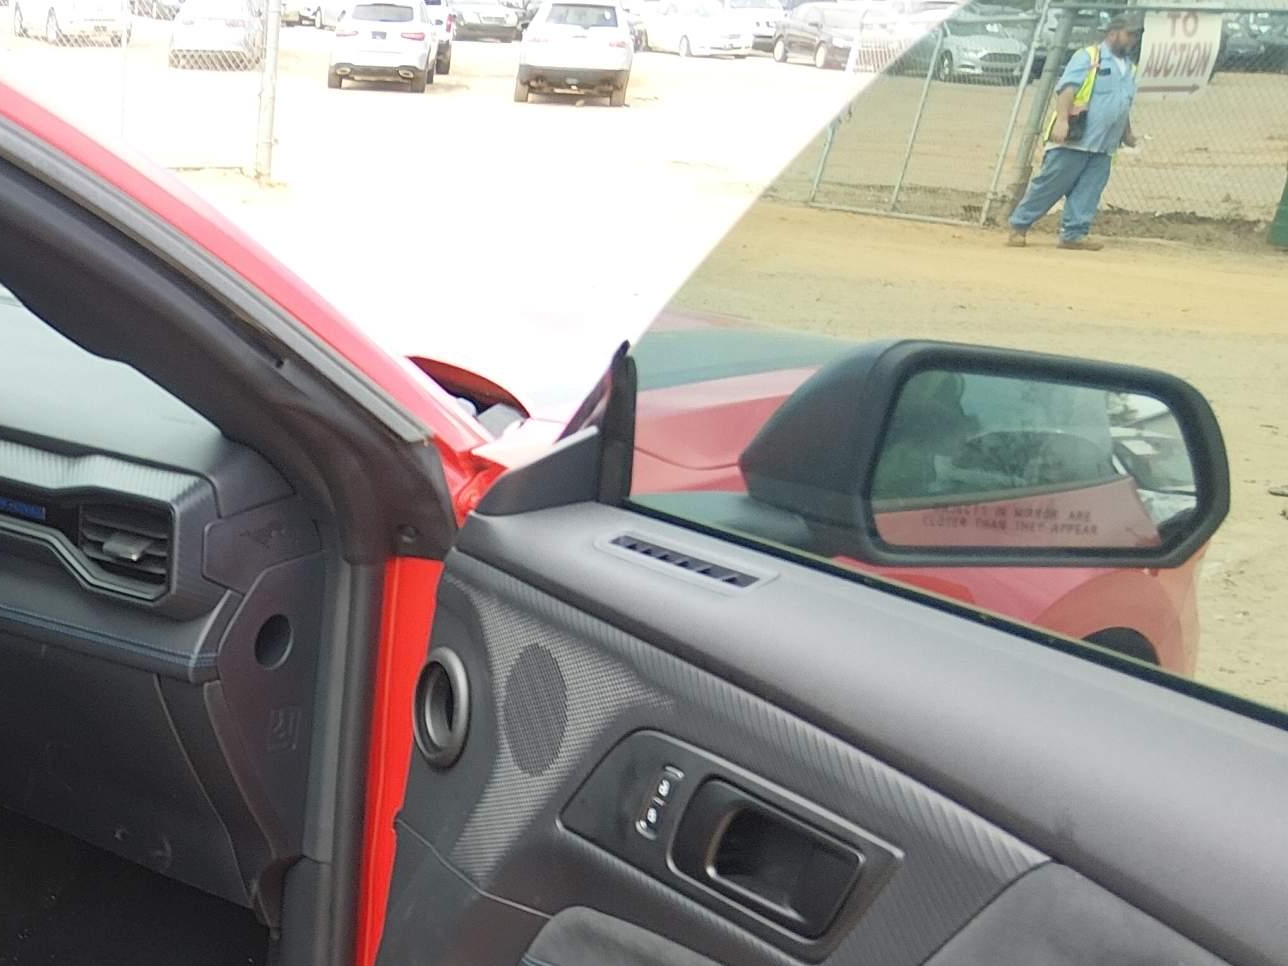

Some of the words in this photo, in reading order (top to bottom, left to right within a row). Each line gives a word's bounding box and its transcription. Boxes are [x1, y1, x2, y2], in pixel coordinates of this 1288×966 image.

[1167, 10, 1199, 38] TO
[1142, 42, 1212, 77] AUCTION
[1050, 523, 1099, 537] APPEAR
